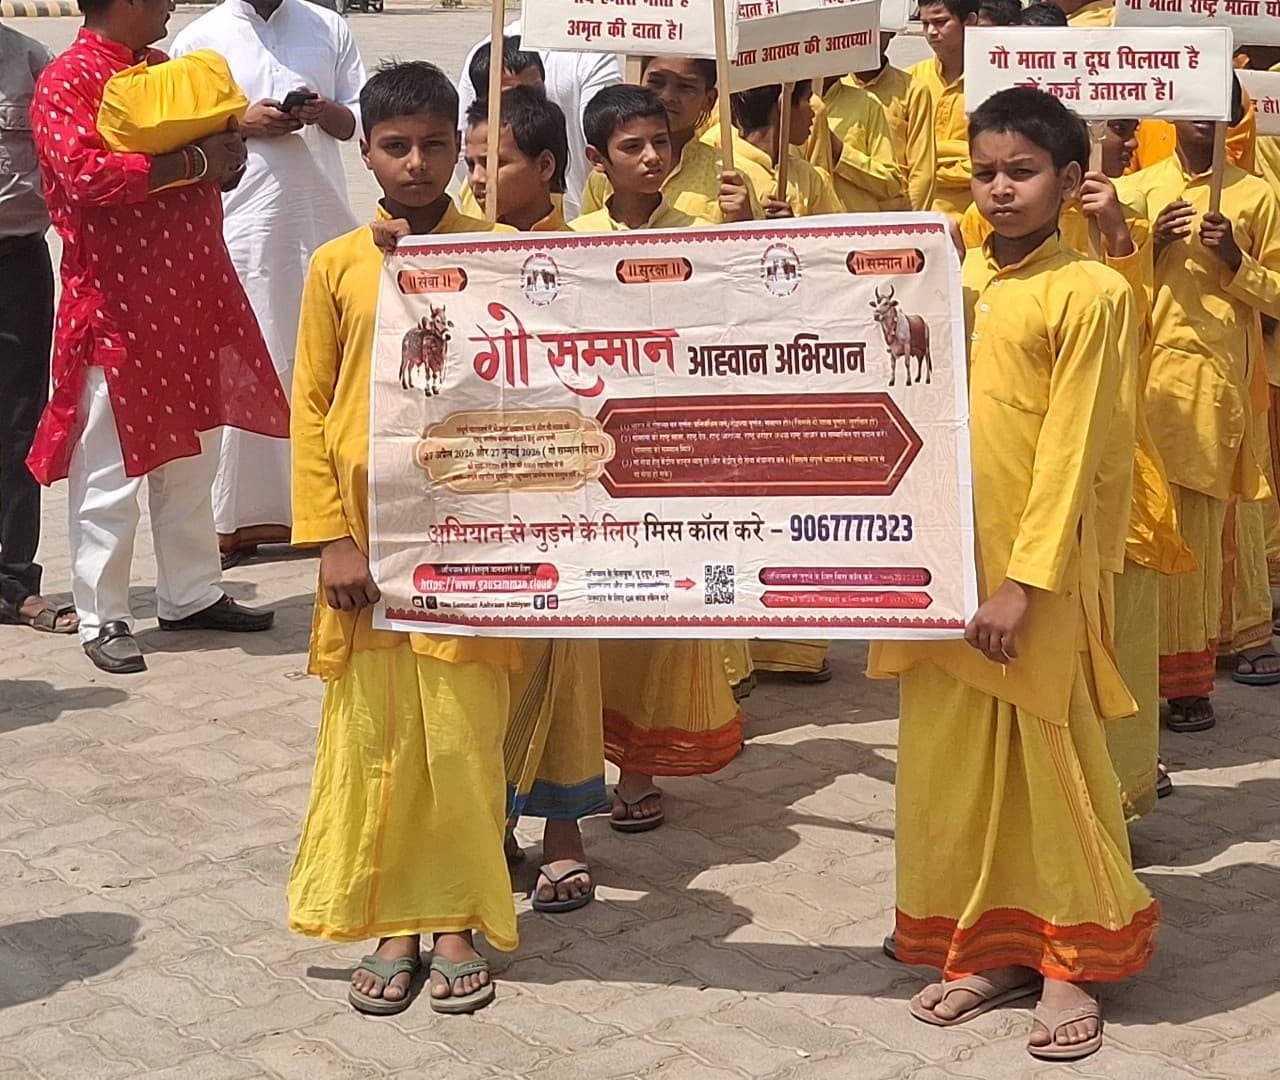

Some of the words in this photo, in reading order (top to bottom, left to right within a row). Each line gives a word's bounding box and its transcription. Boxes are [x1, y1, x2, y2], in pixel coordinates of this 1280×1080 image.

[738, 2, 762, 18] दाता
[1224, 0, 1261, 17] माता
[567, 20, 602, 41] अमृत
[607, 18, 627, 38] की
[632, 22, 663, 39] दाता
[665, 19, 683, 40] है।
[804, 35, 821, 54] की
[989, 46, 1010, 69] गौ
[1016, 51, 1057, 69] माता
[1063, 51, 1077, 69] न
[1116, 46, 1181, 69] पिलाया
[1185, 45, 1200, 70] है
[1088, 82, 1148, 101] उतारना
[1153, 77, 1174, 101] है।
[865, 257, 903, 270] सम्मान
[537, 328, 680, 398] सम्मान
[774, 333, 867, 375] अभियान
[428, 516, 505, 546] अभियान
[507, 514, 527, 543] से
[529, 514, 576, 552] जुड़ने
[578, 514, 598, 543] के
[601, 513, 640, 548] लिए
[643, 512, 683, 542] मिस
[687, 513, 729, 542] कॉल
[733, 512, 765, 542] करे
[790, 514, 913, 542] 9067777323
